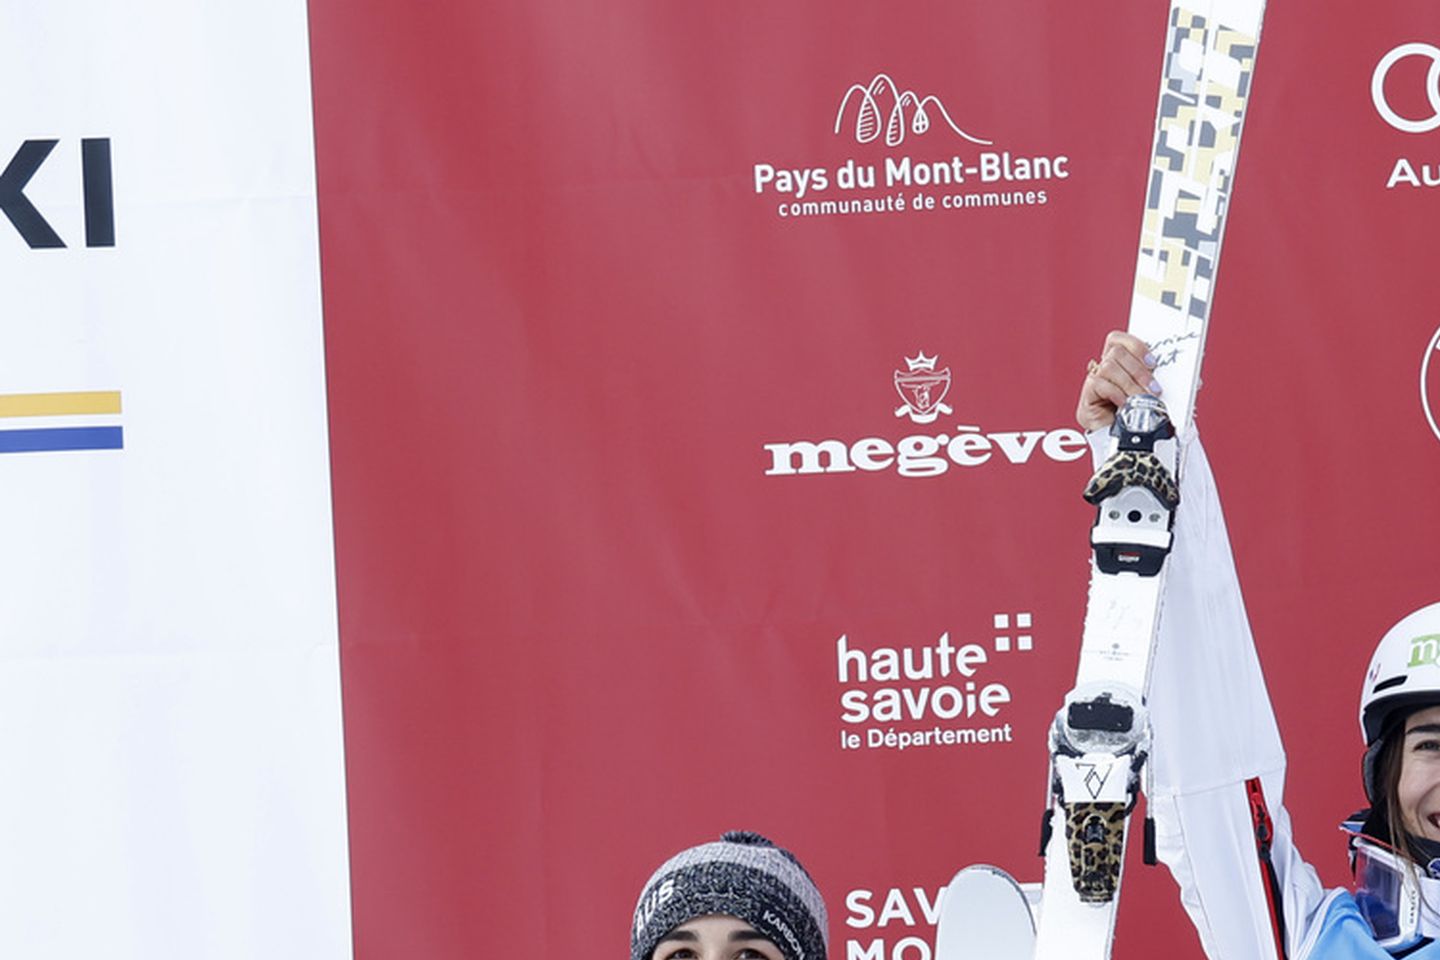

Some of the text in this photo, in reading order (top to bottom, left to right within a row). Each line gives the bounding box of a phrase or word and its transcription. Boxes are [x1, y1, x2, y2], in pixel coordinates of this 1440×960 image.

[754, 152, 1069, 198] Pays du Mont-Blanc
[778, 190, 1048, 217] communauté de communes
[837, 631, 988, 683] haute
[840, 681, 1012, 723] savoie
[841, 723, 1013, 750] le Département
[763, 910, 806, 960] KARBON
